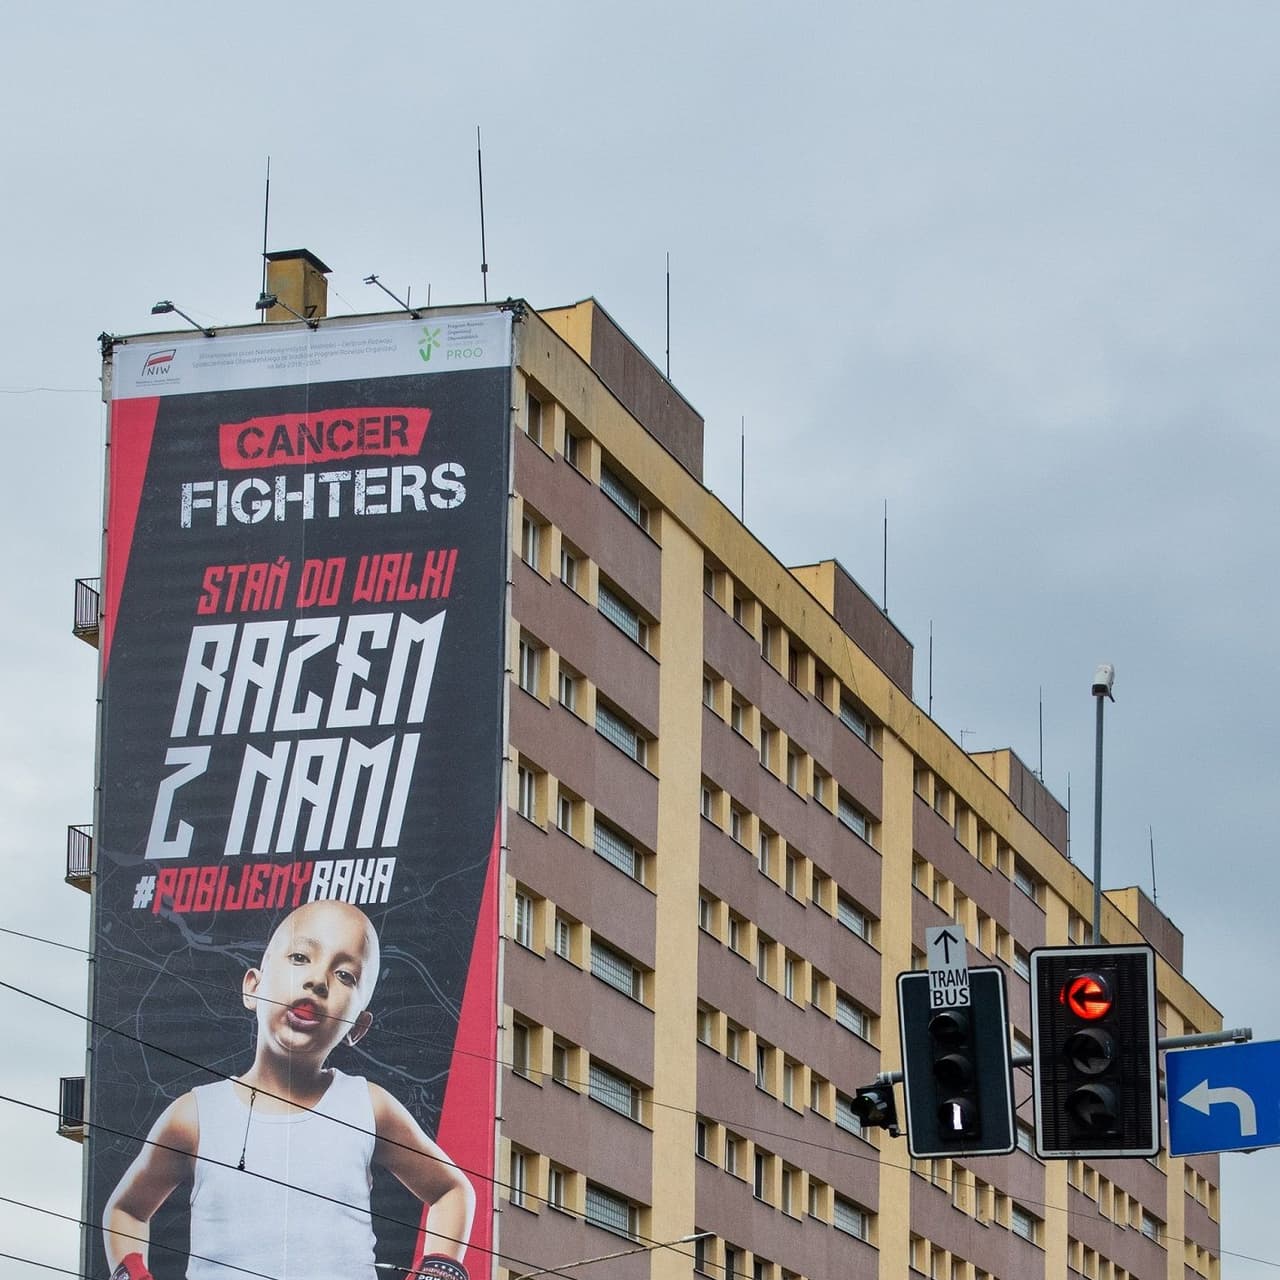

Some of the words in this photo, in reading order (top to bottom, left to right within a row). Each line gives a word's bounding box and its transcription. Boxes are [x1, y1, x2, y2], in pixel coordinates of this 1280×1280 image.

[147, 364, 171, 376] NIW
[446, 347, 483, 360] PROO
[236, 414, 410, 460] CANCER
[180, 461, 467, 529] FIGHTERS
[196, 555, 289, 615] STAŃ
[296, 558, 346, 608] DO
[354, 548, 458, 602] WALKI
[170, 609, 447, 738] RAZEM
[144, 745, 212, 860] Z
[223, 733, 421, 856] NAMI
[930, 968, 969, 988] TRAM
[933, 988, 970, 1007] BUS
